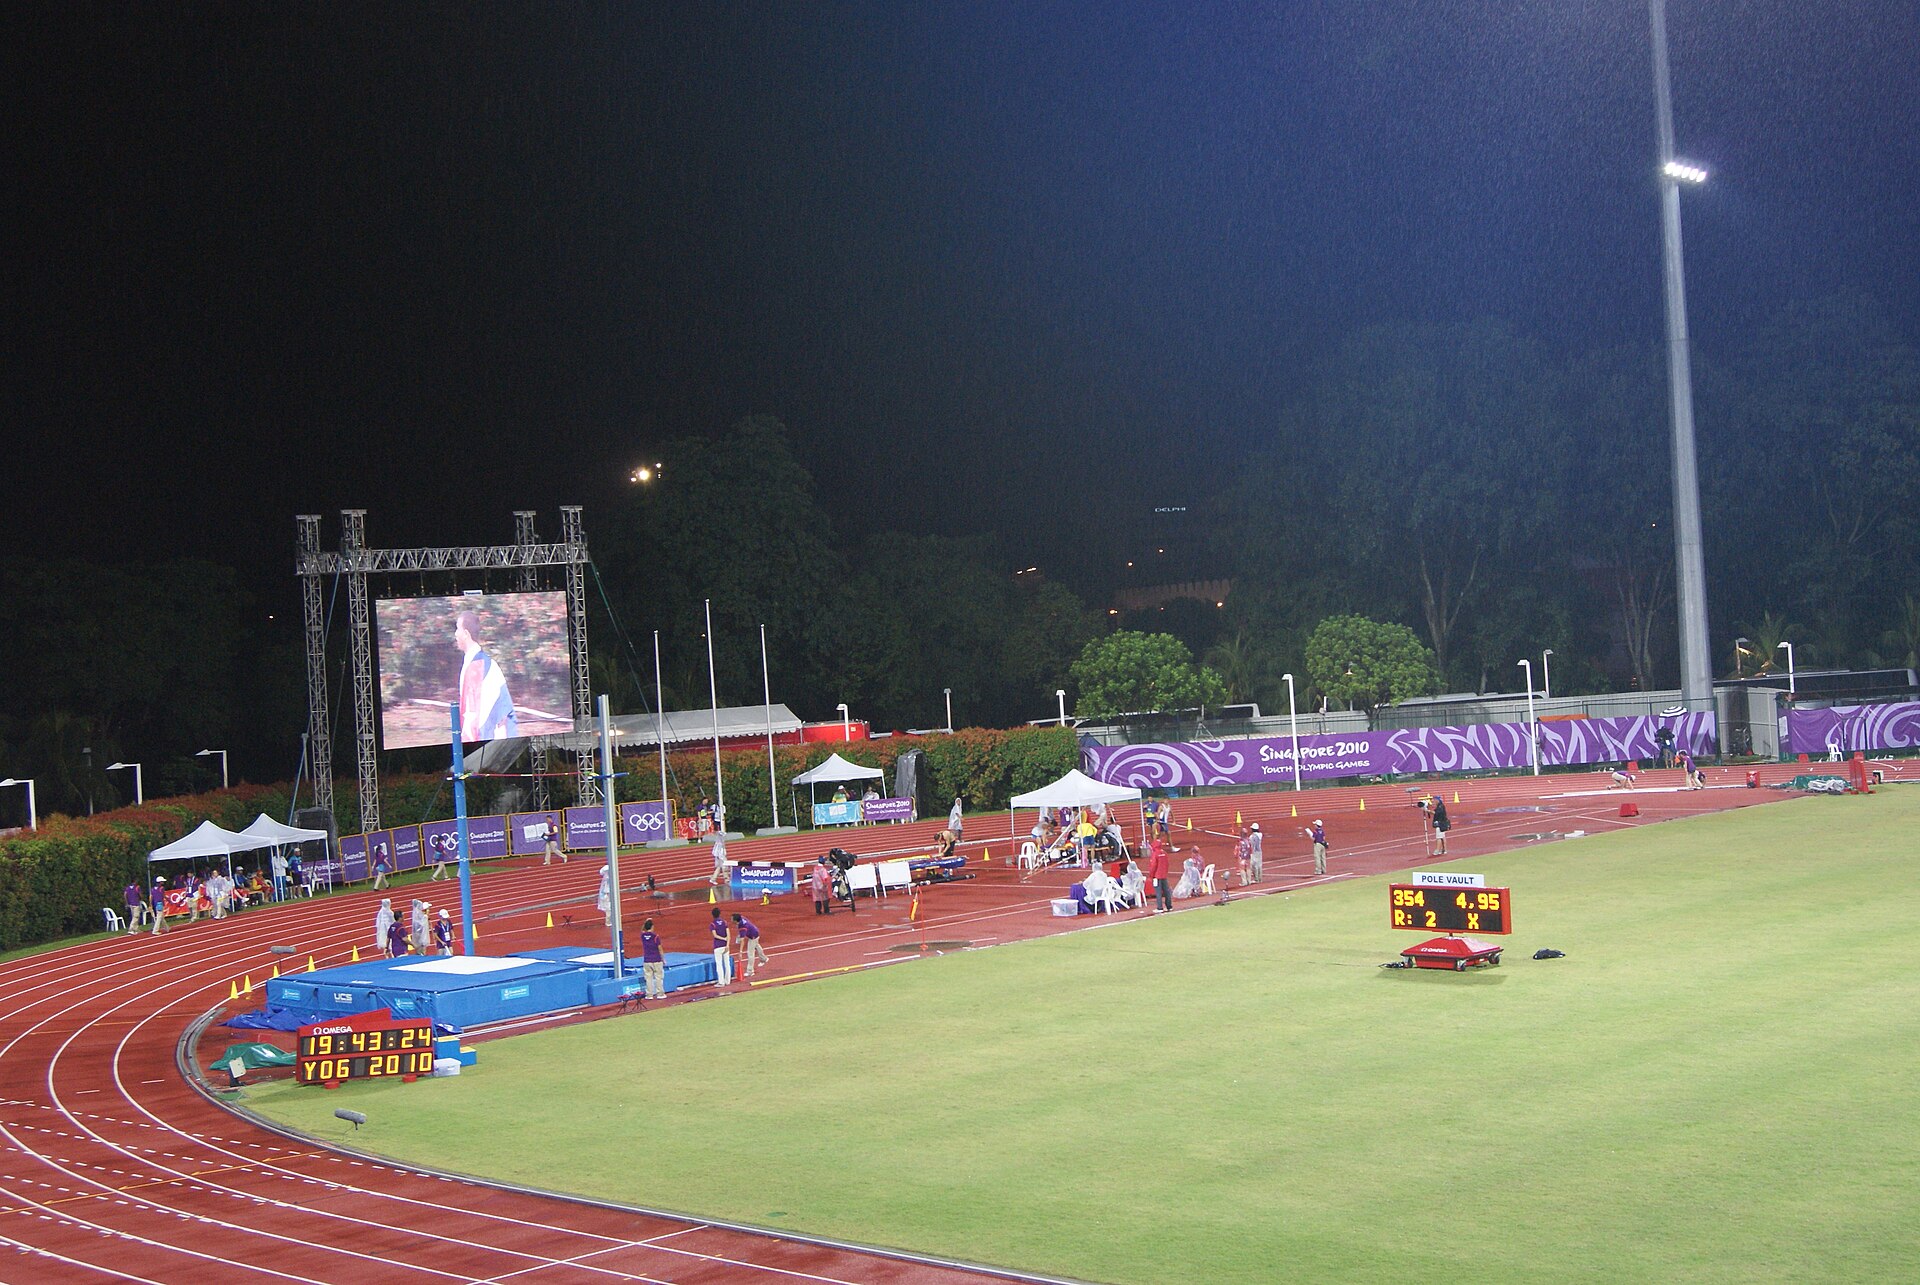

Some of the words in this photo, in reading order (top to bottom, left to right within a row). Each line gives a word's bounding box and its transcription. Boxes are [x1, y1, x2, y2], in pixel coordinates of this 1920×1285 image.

[1334, 741, 1370, 757] 2010
[1261, 765, 1294, 775] YOUTH
[1336, 760, 1371, 770] GAMES
[1421, 875, 1444, 884] POLE
[1446, 876, 1475, 885] VAULT
[1393, 889, 1425, 907] 354
[1394, 909, 1413, 926] R:
[1425, 910, 1437, 928] 2
[1467, 912, 1479, 930] X
[333, 992, 353, 1001] UCS
[322, 1026, 353, 1035] OMEGA
[309, 1027, 431, 1056] 19:43:24
[304, 1058, 350, 1081] YOG
